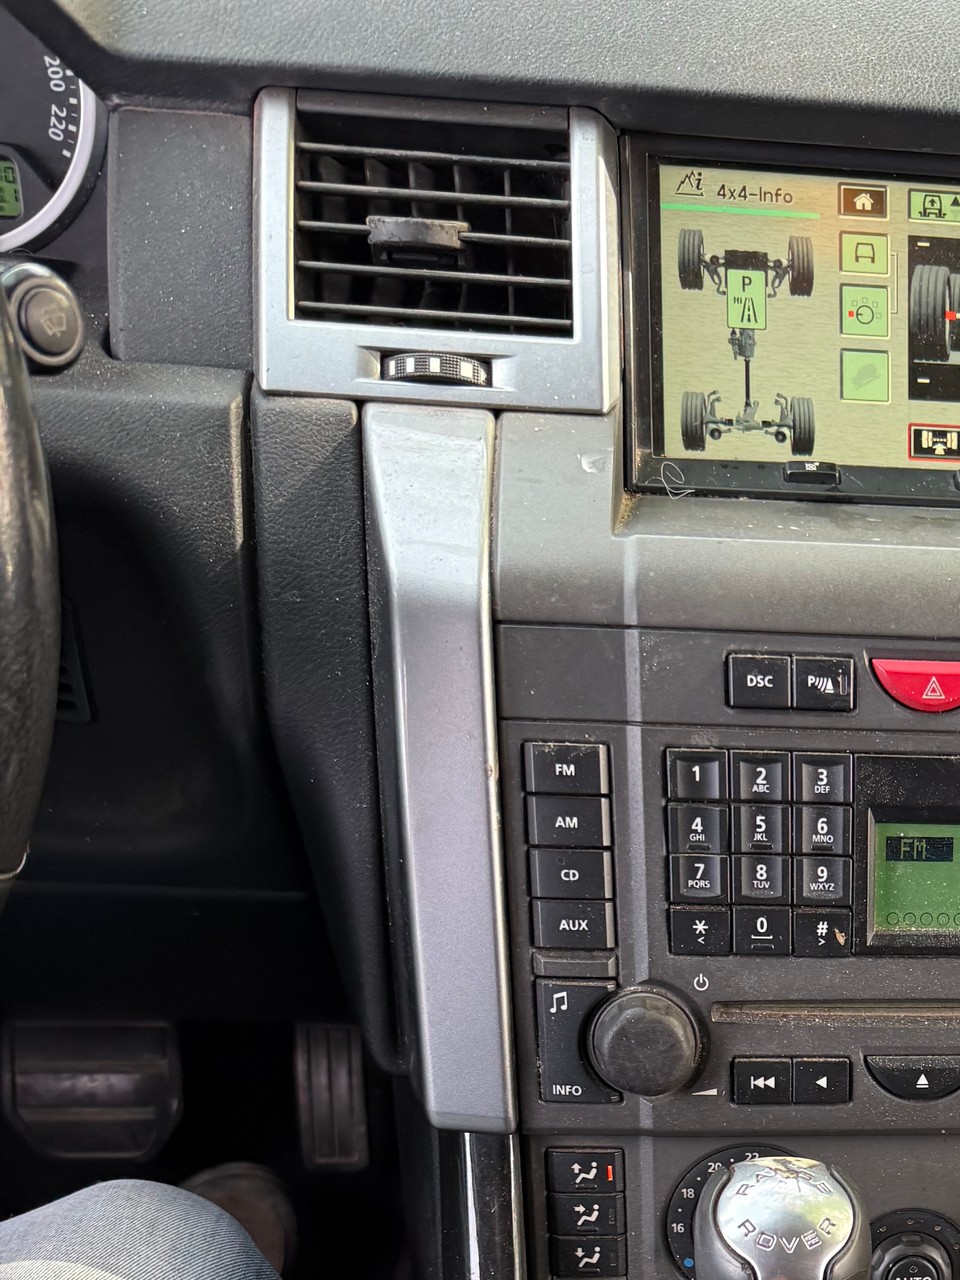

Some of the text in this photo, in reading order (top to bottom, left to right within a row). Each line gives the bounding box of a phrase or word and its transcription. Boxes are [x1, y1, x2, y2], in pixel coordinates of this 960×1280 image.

[43, 55, 66, 93] 200
[48, 104, 67, 142] 220
[717, 183, 793, 204] 4x4-Info
[741, 275, 752, 292] P
[746, 674, 774, 689] DSC
[555, 764, 576, 776] FM
[692, 766, 700, 782] 1
[756, 768, 767, 784] 2
[817, 769, 828, 785] 3
[752, 784, 770, 793] ABC
[814, 785, 831, 794] DEF
[555, 816, 578, 828] AM
[691, 817, 703, 832] 4
[756, 816, 766, 832] 5
[817, 818, 828, 834] 6
[689, 833, 705, 842] GHI
[753, 832, 768, 841] JKL
[812, 834, 834, 843] MNO
[900, 839, 927, 859] FM
[560, 869, 579, 882] CD
[694, 864, 705, 880] 7
[756, 864, 767, 880] 8
[817, 866, 828, 882] 9
[688, 880, 710, 889] PQRS
[753, 880, 770, 889] TUV
[809, 882, 835, 891] WXYZ
[559, 919, 588, 931] AUX
[757, 917, 768, 933] 0
[552, 1084, 582, 1096] INFO
[708, 1162, 723, 1173] 20
[681, 1188, 695, 1199] 18
[671, 1223, 685, 1234] 16
[737, 1216, 838, 1254] ROVER
